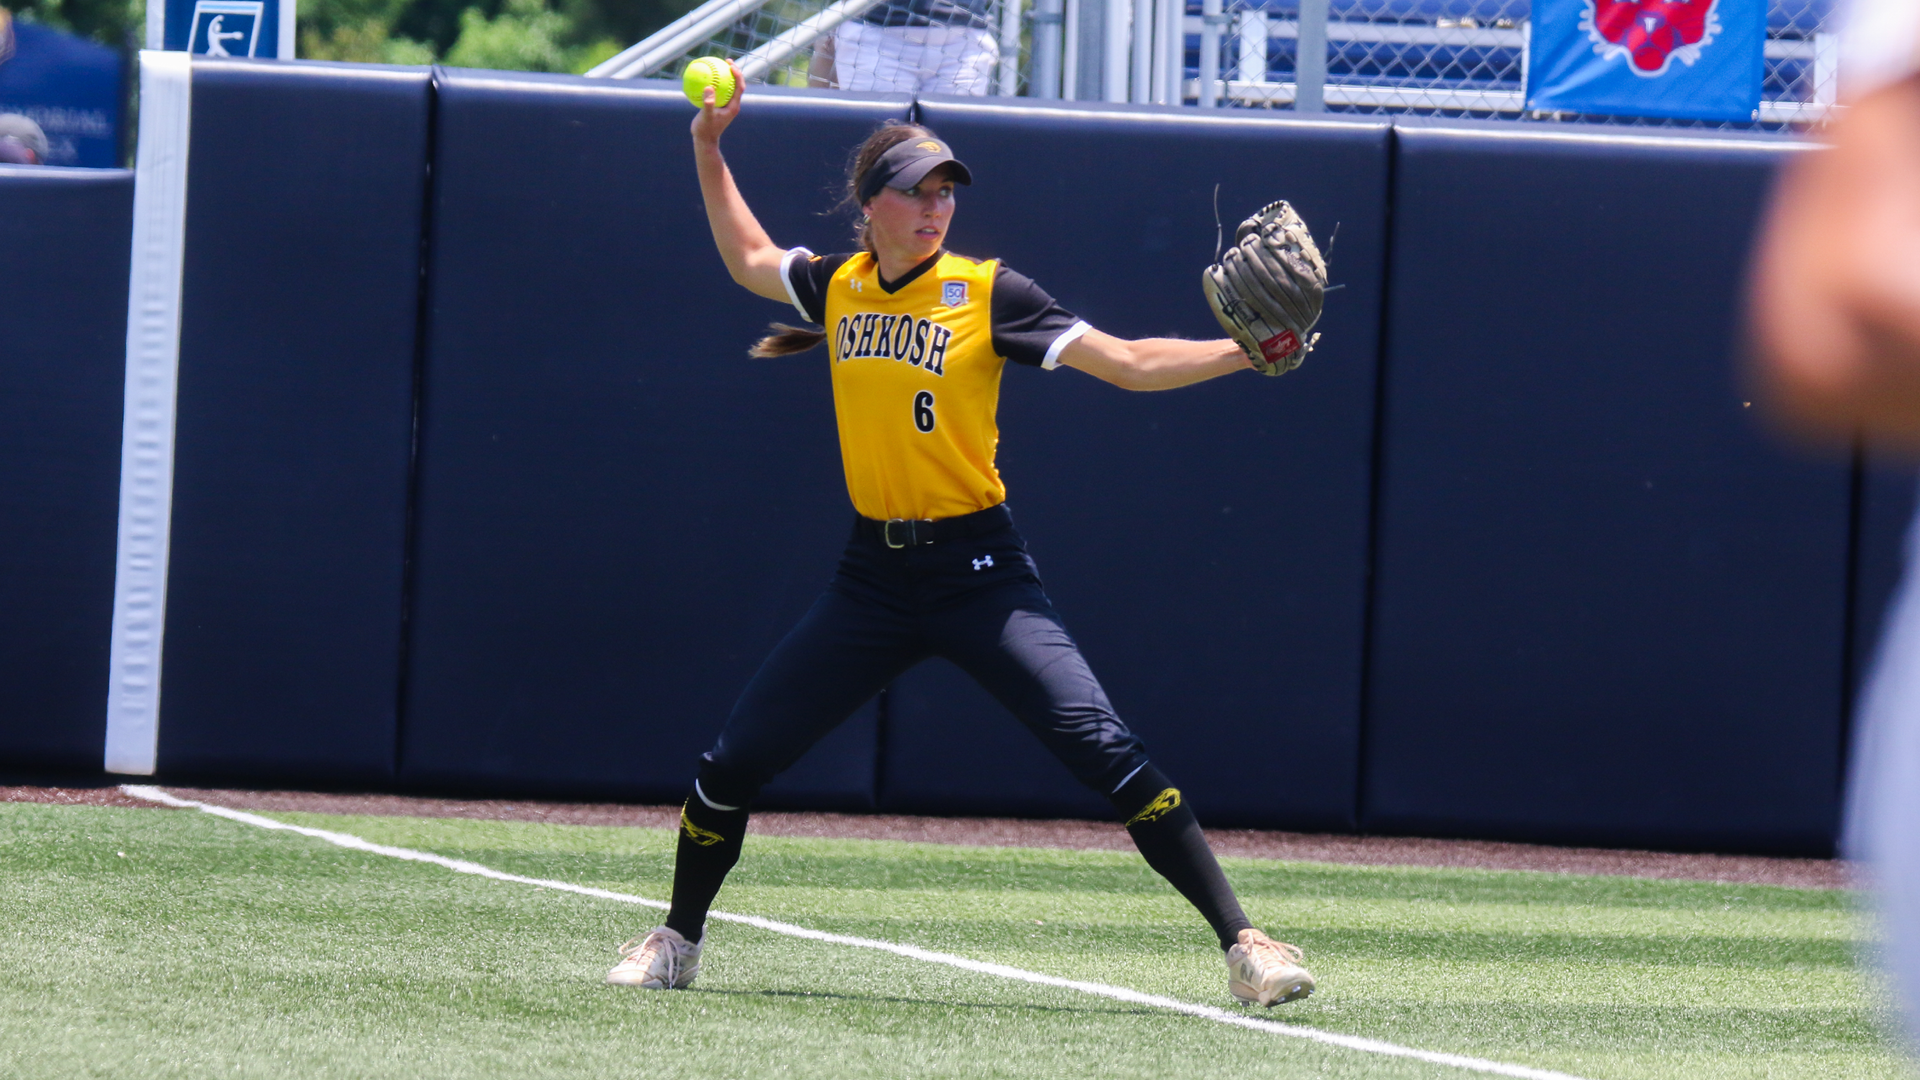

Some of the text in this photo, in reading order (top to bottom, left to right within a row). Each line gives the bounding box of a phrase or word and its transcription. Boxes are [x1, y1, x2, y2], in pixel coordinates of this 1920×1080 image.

[947, 288, 961, 298] 50
[835, 313, 953, 377] OSHKOSH
[913, 389, 936, 434] 6
